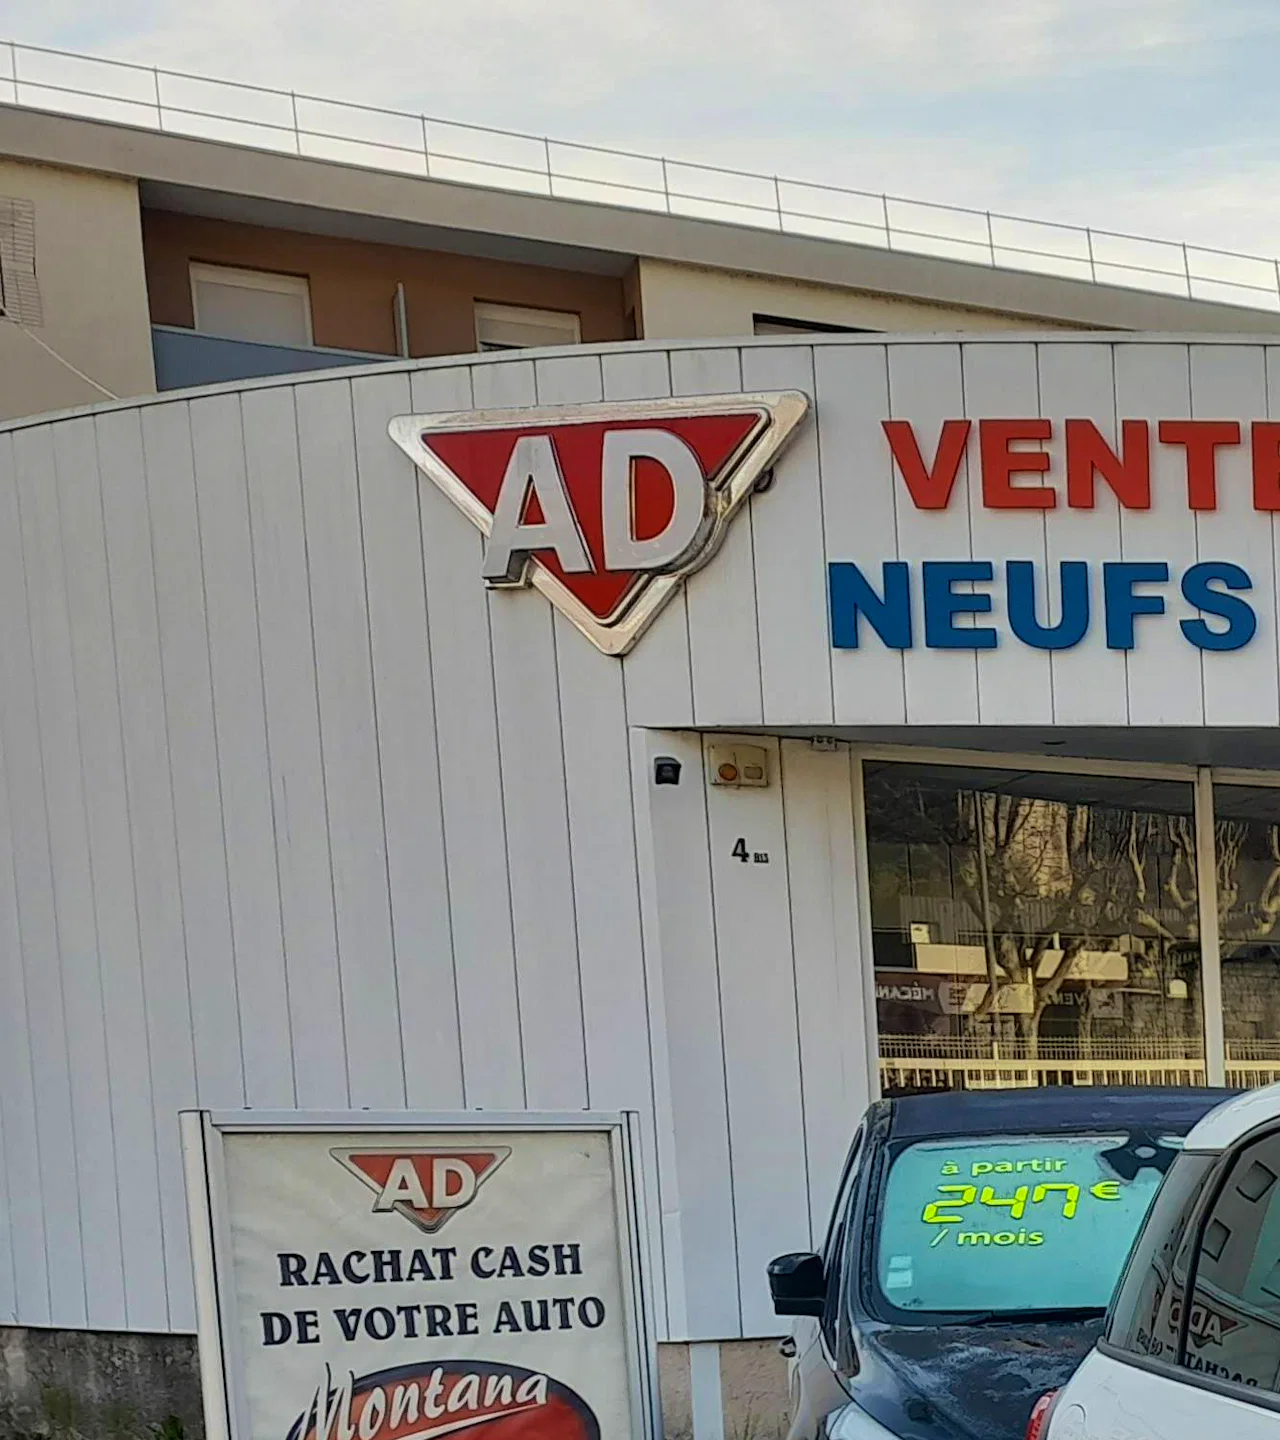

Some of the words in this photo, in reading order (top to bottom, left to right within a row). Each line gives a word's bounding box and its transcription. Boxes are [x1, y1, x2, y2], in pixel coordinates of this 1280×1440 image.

[482, 428, 707, 580] AD
[828, 560, 1257, 652] NEUFS
[731, 838, 749, 862] 4
[375, 1156, 478, 1210] AD
[941, 1159, 960, 1175] à
[971, 1157, 1068, 1177] partir
[957, 1228, 1045, 1246] mois
[276, 1246, 457, 1287] RACHAT
[470, 1243, 583, 1279] CASH
[260, 1309, 321, 1346] DE
[334, 1302, 480, 1341] VOTRE
[493, 1296, 606, 1334] AUTO
